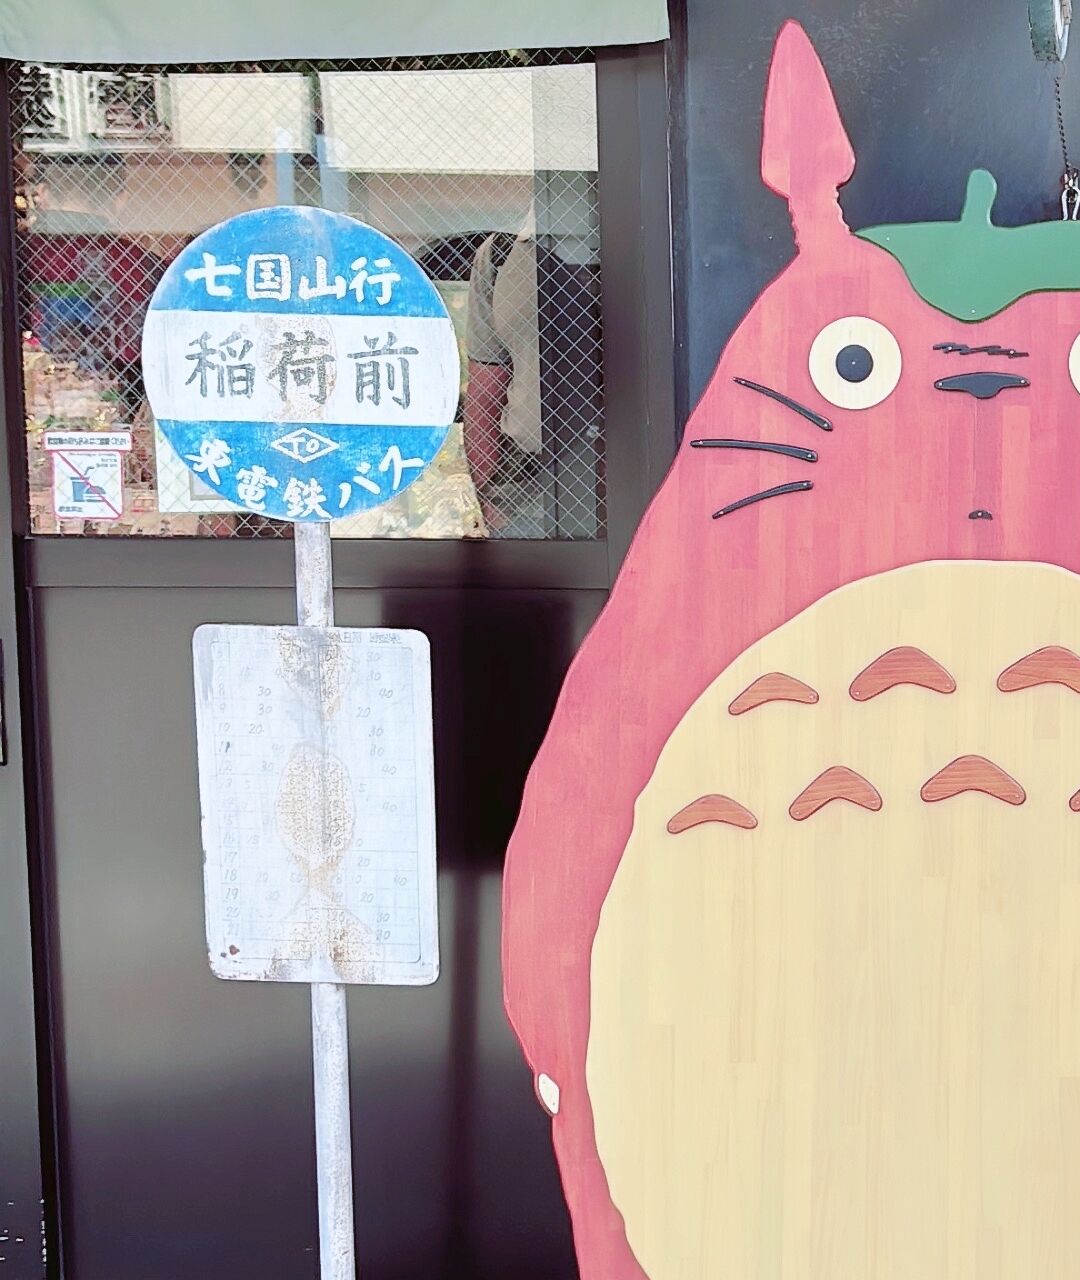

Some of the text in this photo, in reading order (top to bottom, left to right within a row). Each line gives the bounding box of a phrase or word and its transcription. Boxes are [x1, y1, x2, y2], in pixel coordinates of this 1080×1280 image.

[184, 251, 402, 306] 七国山行
[184, 329, 420, 410] 稲荷前
